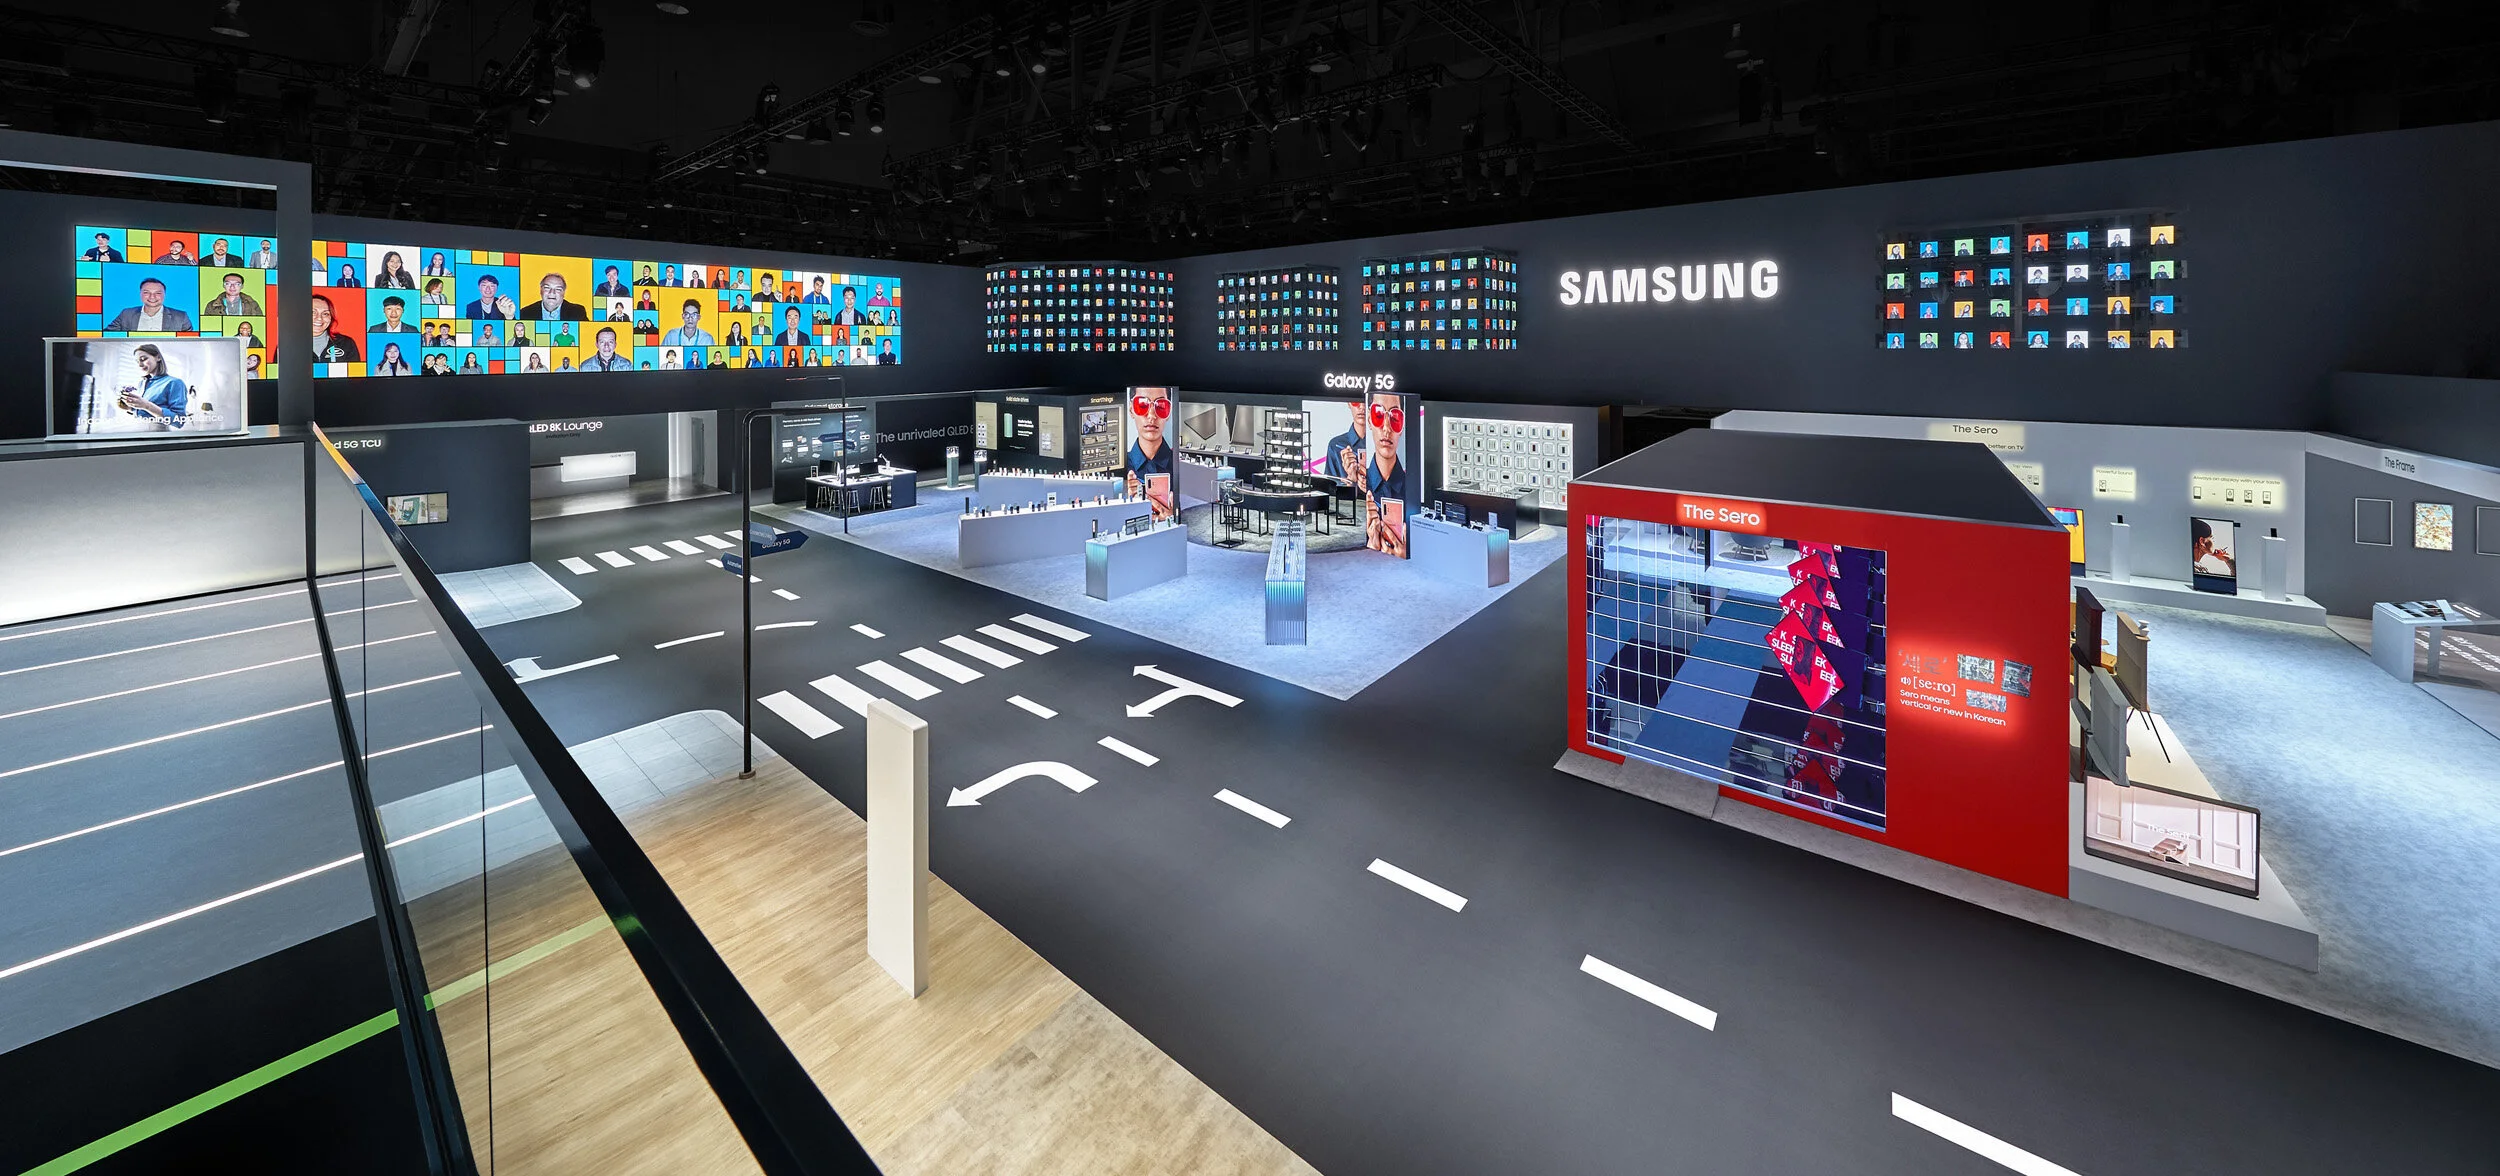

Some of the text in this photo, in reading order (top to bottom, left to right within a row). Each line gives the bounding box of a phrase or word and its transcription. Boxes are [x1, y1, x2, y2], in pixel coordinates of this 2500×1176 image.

[1560, 260, 1778, 305] SAMSUNG
[1324, 372, 1395, 393] Galaxy 5G
[549, 422, 562, 432] 8K
[563, 421, 603, 432] Lounge
[876, 432, 895, 443] The
[897, 427, 945, 441] unrivaled
[947, 424, 969, 436] QLED
[1952, 424, 1998, 434] The Sero
[343, 440, 359, 449] 5G
[360, 439, 382, 448] TCU
[2384, 456, 2416, 474] The Frame
[1683, 504, 1760, 526] The Sero
[1920, 694, 1950, 706] means
[1900, 698, 2006, 727] vertical or new in Korean
